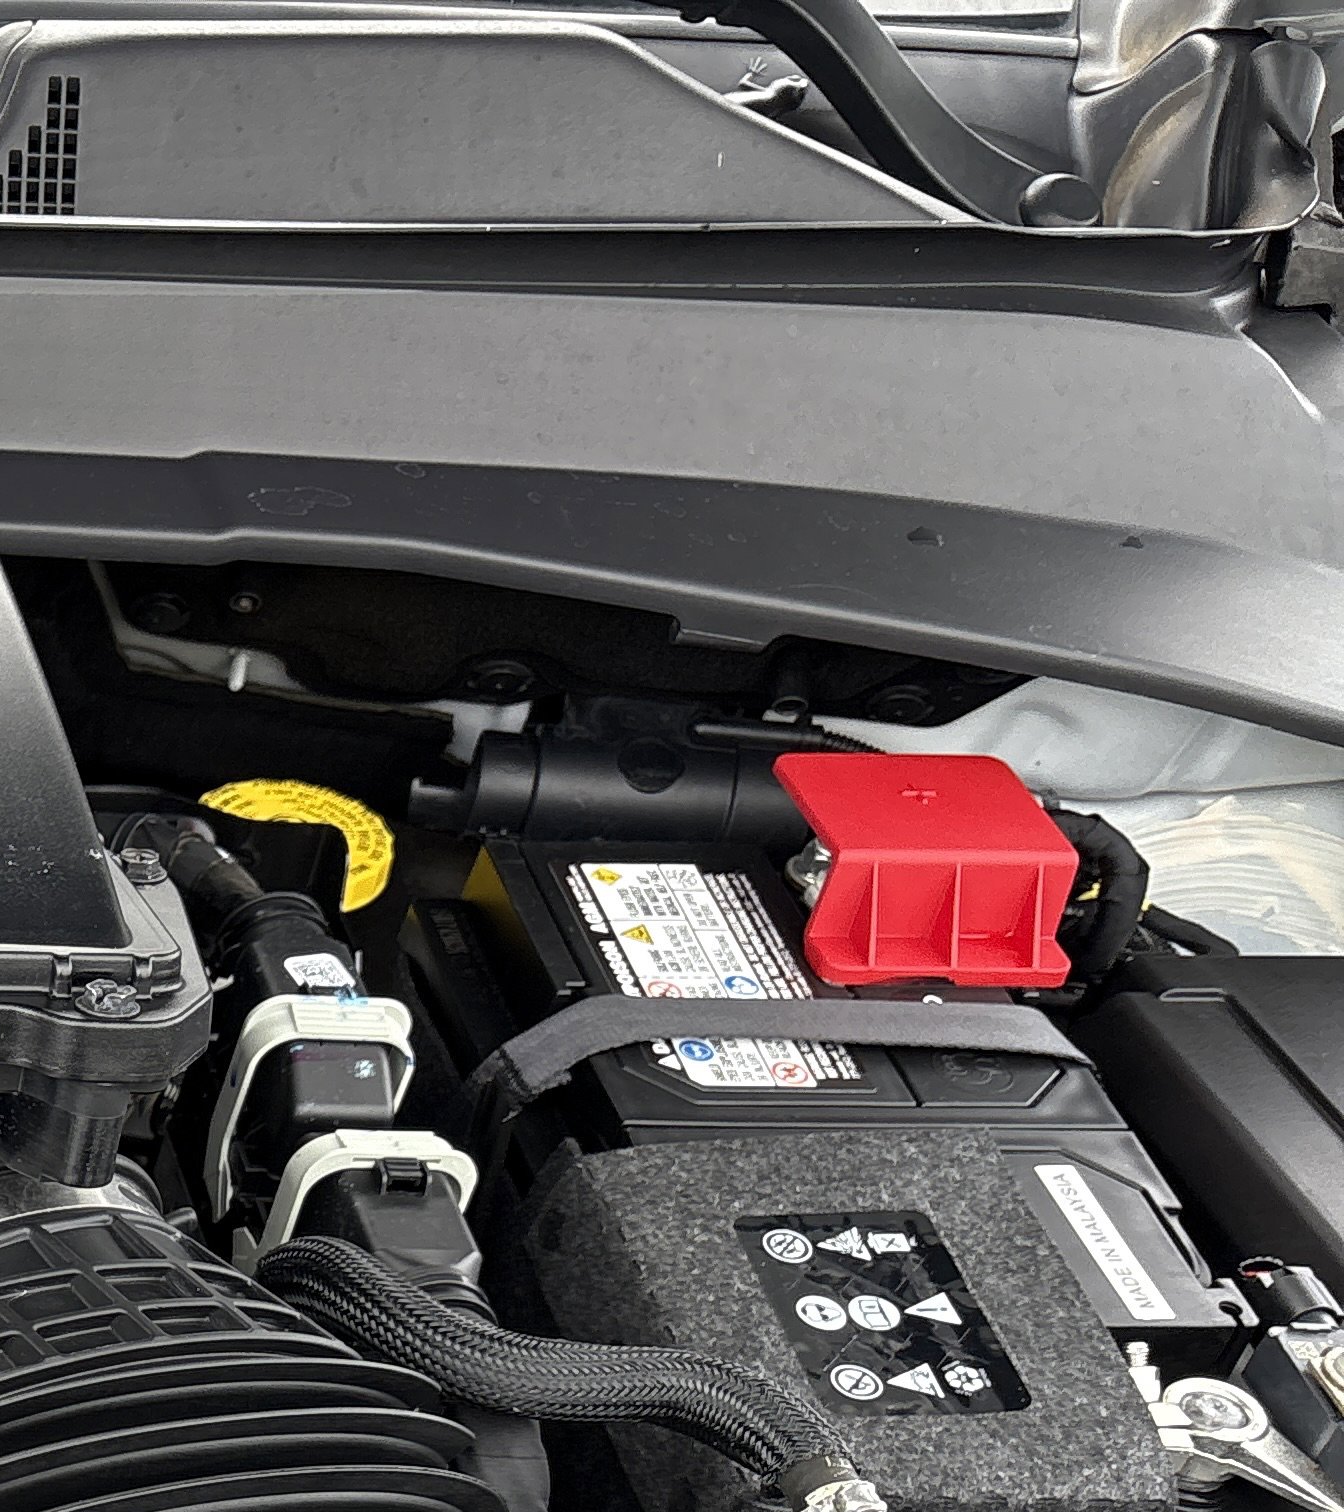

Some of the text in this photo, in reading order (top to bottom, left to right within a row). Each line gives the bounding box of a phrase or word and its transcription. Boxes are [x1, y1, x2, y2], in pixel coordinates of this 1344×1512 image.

[1053, 1173, 1155, 1308] MADE IN MALAYSIA
